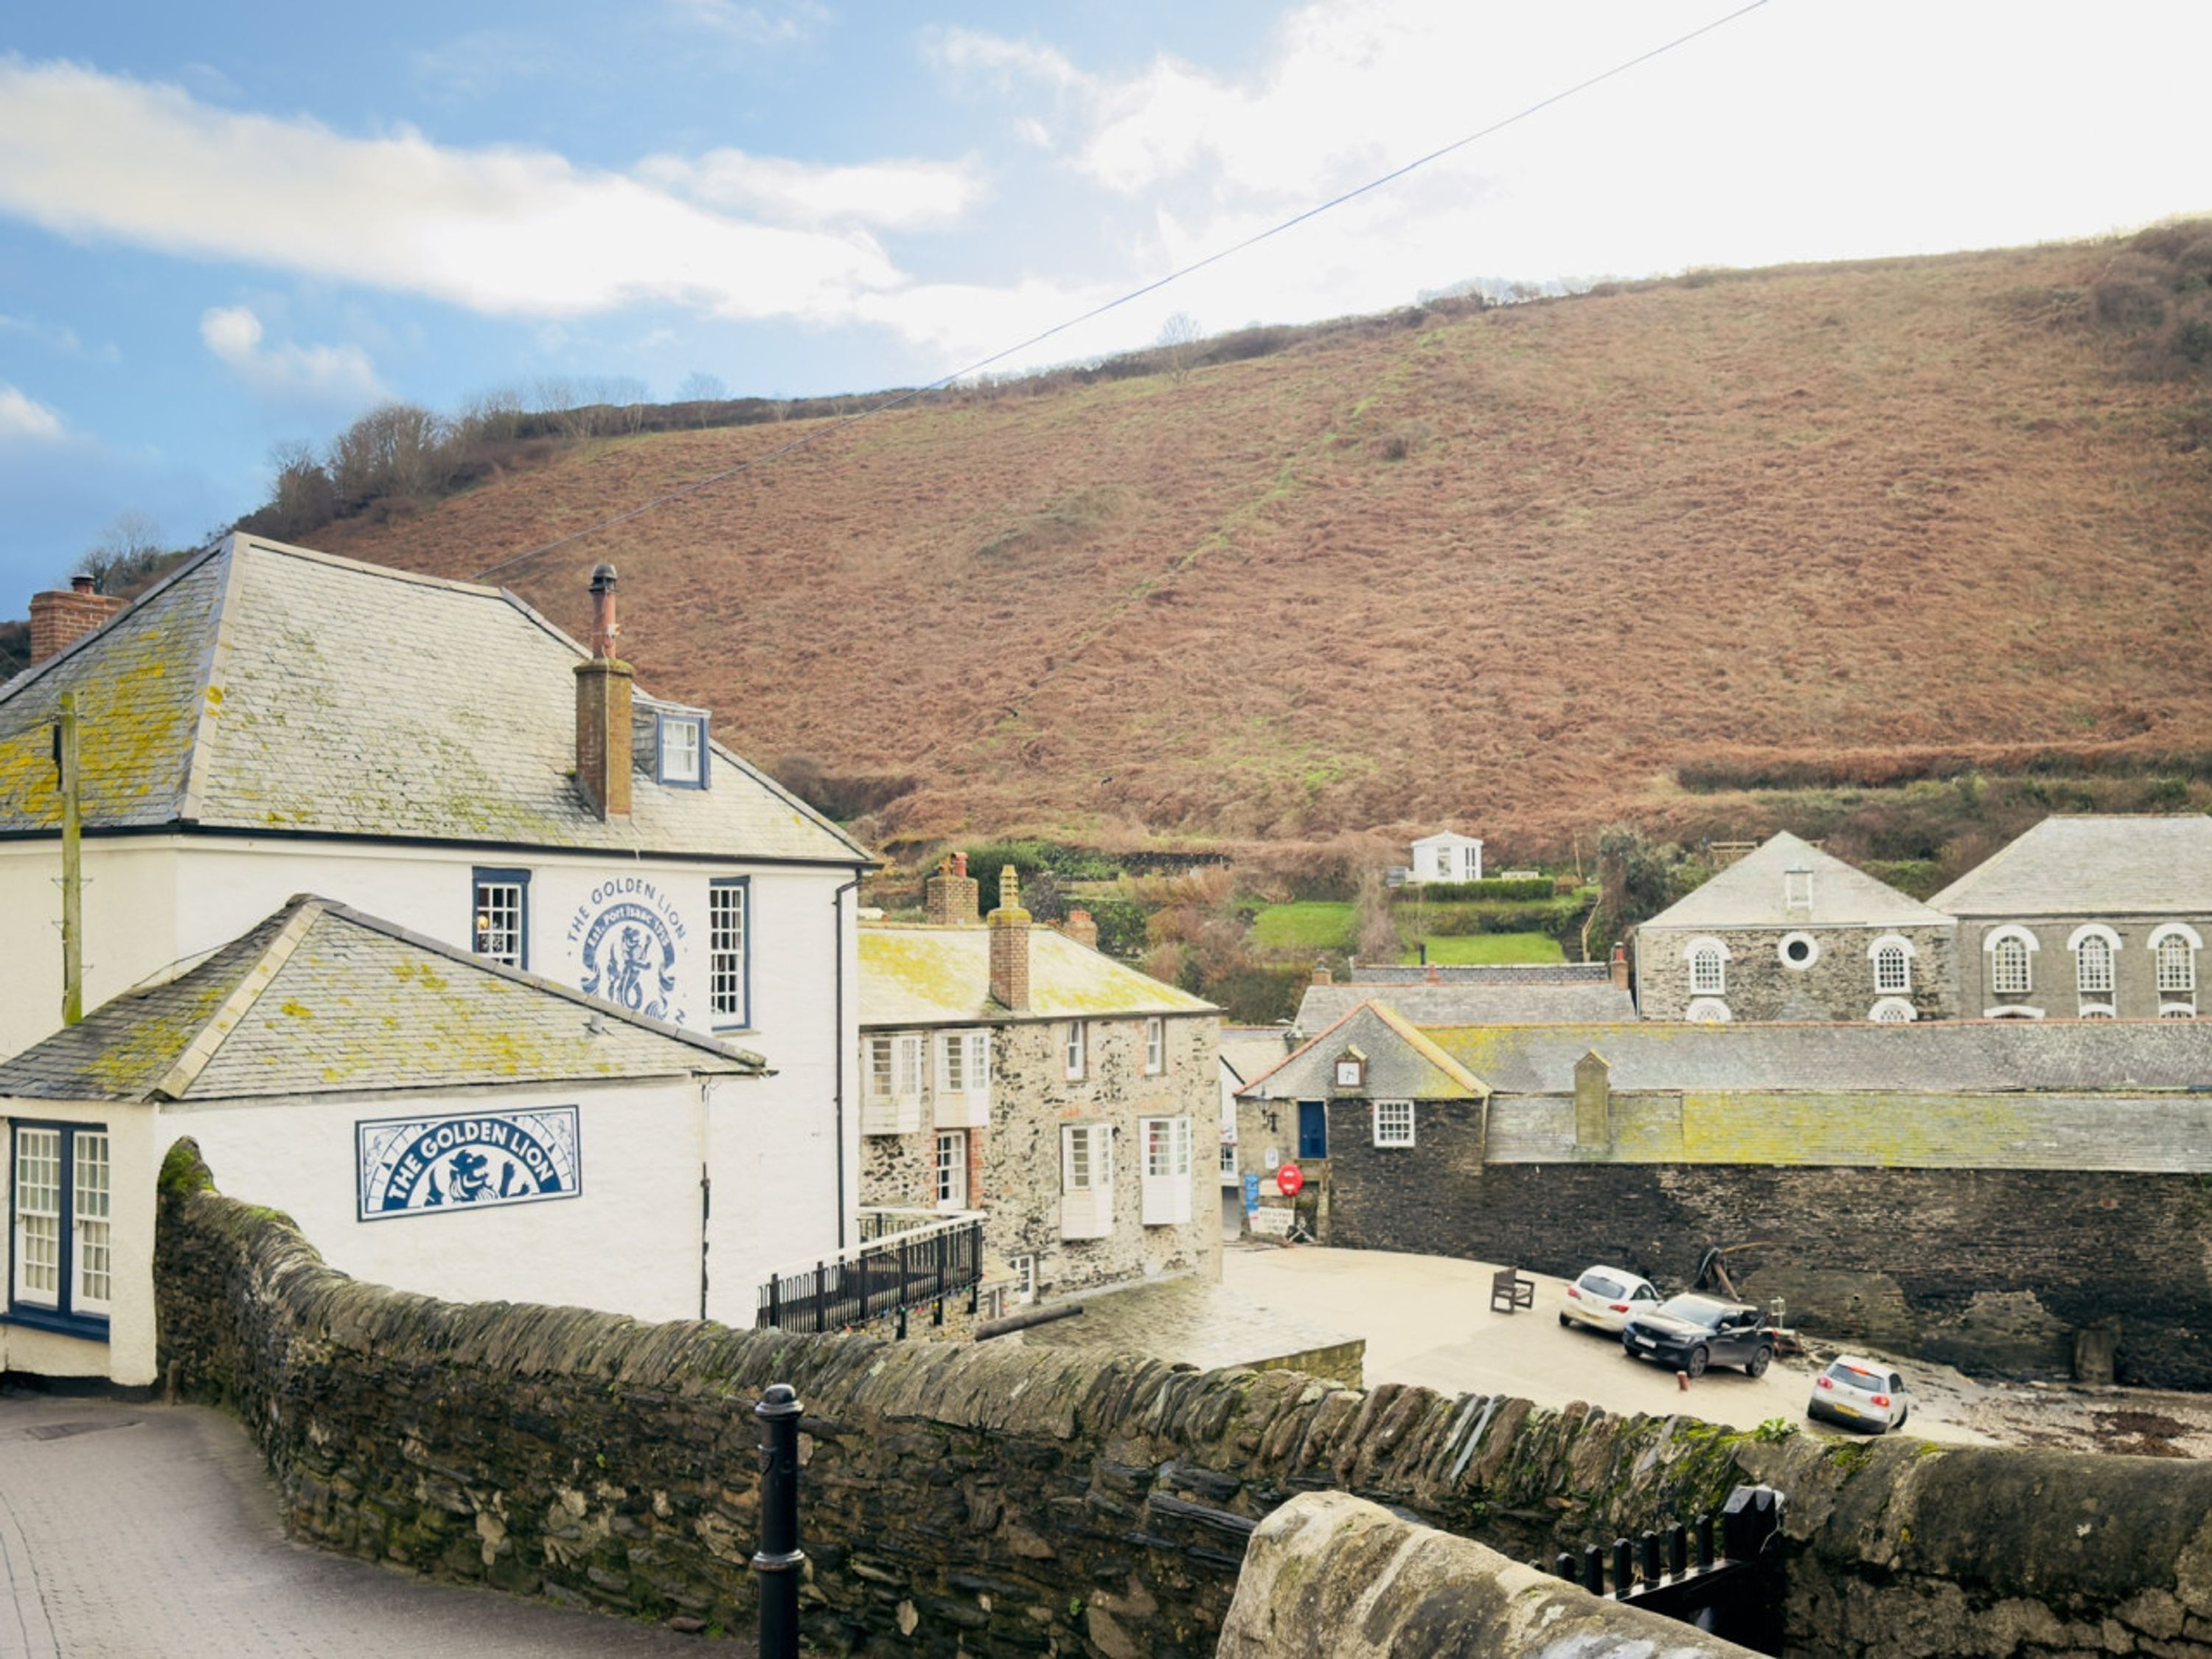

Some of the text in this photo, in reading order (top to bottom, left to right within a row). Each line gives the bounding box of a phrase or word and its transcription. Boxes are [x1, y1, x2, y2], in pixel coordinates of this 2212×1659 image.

[568, 877, 686, 942] THE GOLDEN LION
[602, 906, 625, 925] Port
[388, 1121, 554, 1200] THE GOLDEN LION
